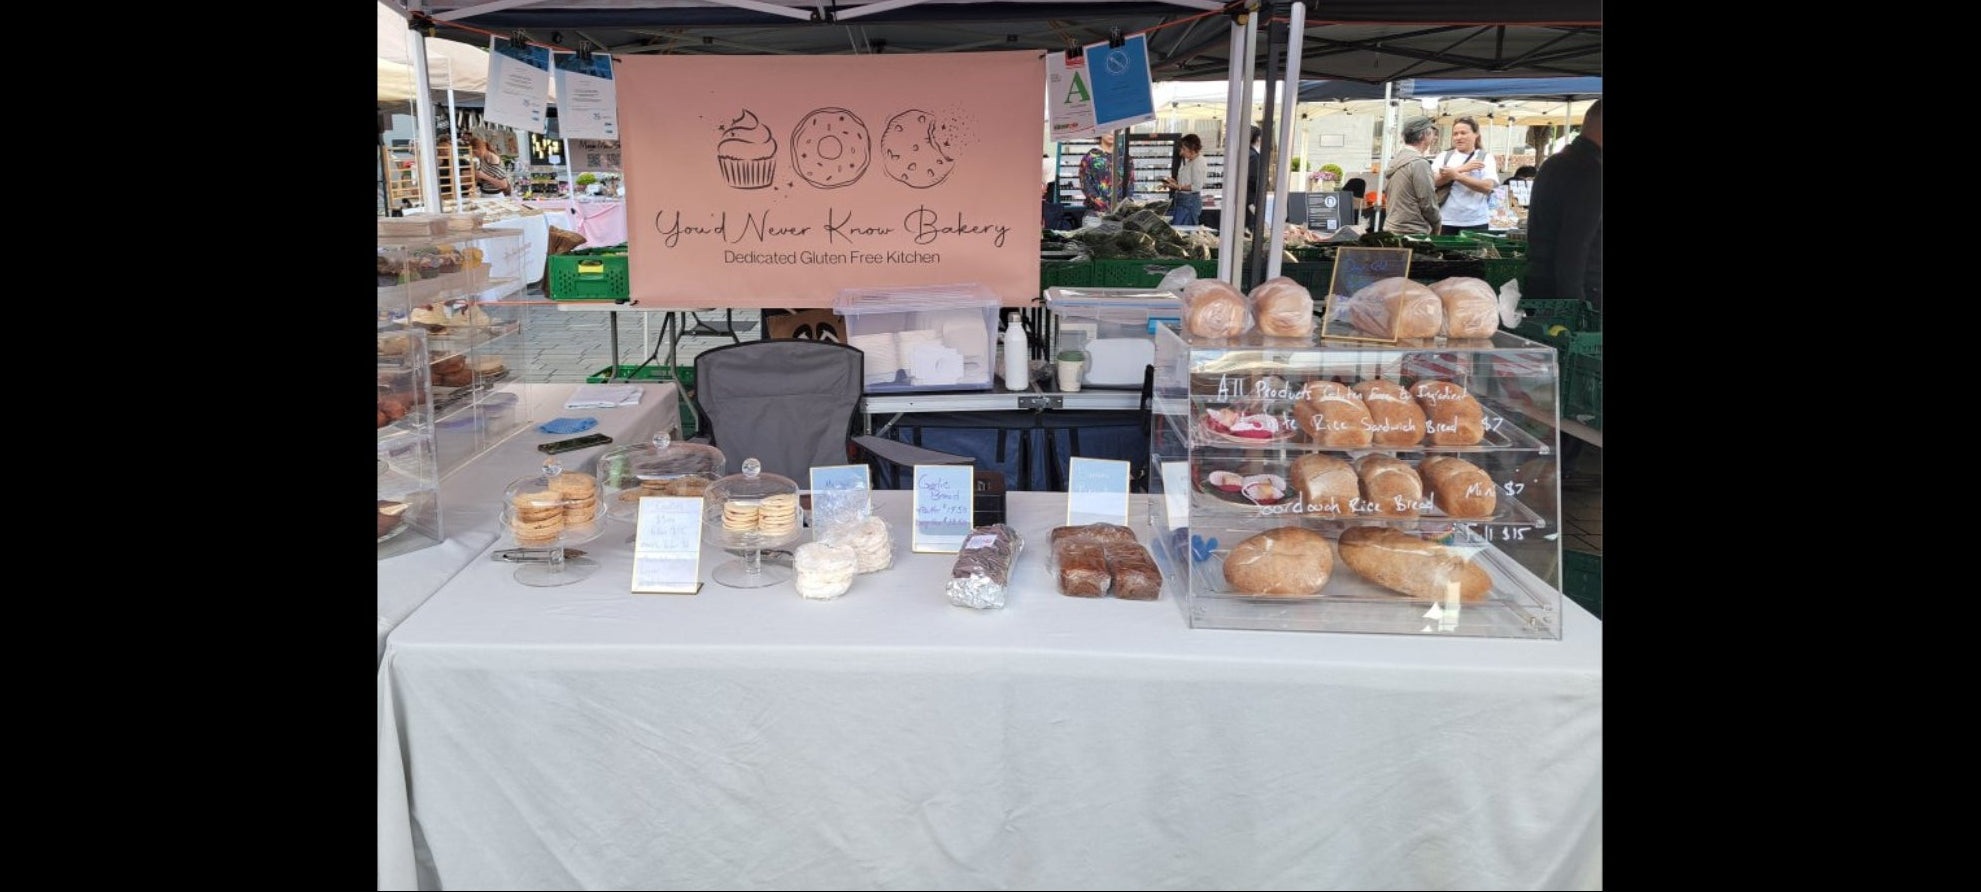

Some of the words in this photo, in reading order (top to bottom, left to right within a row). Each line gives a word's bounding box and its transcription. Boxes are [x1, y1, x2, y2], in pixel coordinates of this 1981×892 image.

[1063, 71, 1091, 104] A
[655, 209, 727, 248] You'd
[730, 208, 811, 244] Never
[823, 207, 895, 244] Know
[903, 204, 1011, 248] Bakery
[724, 250, 796, 265] Dedicated
[799, 250, 847, 265] Gluten
[850, 250, 884, 264] Free
[887, 250, 941, 264] Kitchen
[1216, 373, 1244, 403] All
[1255, 380, 1312, 399] Products
[1311, 414, 1350, 432] Rice
[1360, 416, 1417, 432] Sandwich
[1425, 416, 1459, 433] Bread
[1481, 416, 1504, 432] $7
[1465, 481, 1497, 499] Mini
[1504, 480, 1525, 496] $7
[1350, 496, 1383, 512] Rice
[1394, 491, 1434, 512] Bread
[1463, 522, 1493, 541] Fll
[1502, 525, 1532, 541] $15
